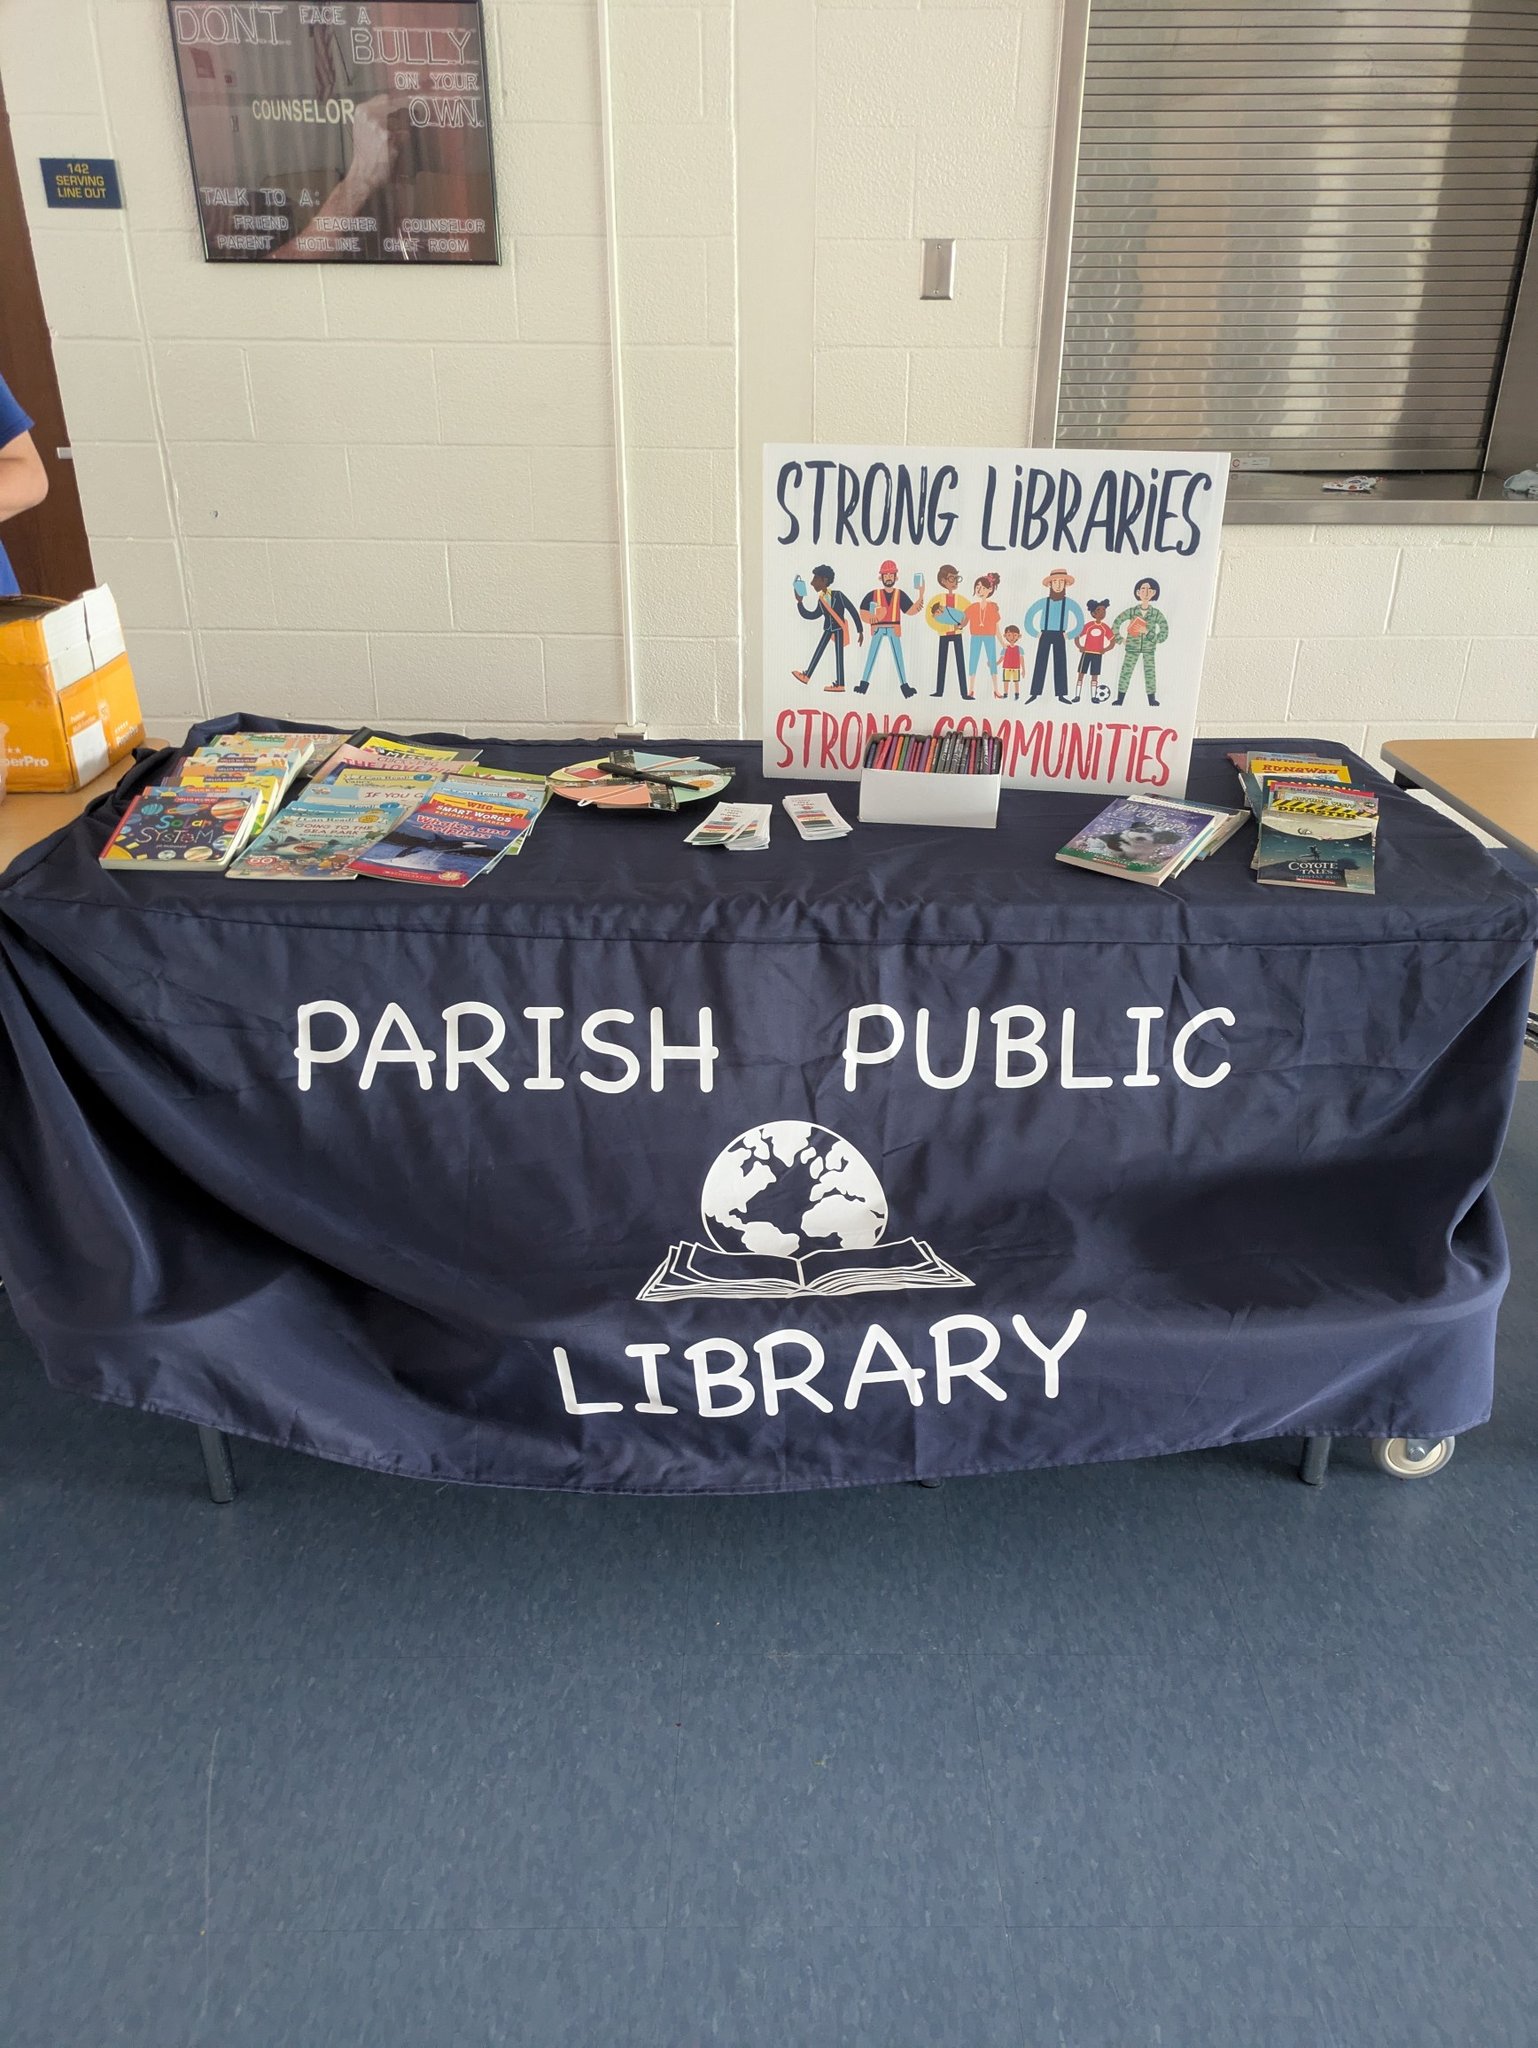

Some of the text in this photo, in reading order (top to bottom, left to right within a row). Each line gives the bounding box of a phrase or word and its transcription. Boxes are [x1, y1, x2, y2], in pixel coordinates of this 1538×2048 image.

[300, 6, 371, 25] FACE A
[351, 28, 472, 65] BULLY
[395, 72, 479, 92] ON YOUR
[251, 98, 355, 125] COUNSELOR
[409, 96, 485, 128] OWN.
[67, 163, 90, 175] 142
[55, 175, 105, 187] SERVING
[57, 187, 107, 199] LINE OUT
[200, 187, 320, 207] TALK TO A:
[233, 214, 486, 233] FRIEND TEACHER COUNSELOR
[217, 235, 470, 253] PARENT HOTLINE CHAT ROOM
[776, 460, 959, 548] STRONG
[364, 791, 381, 799] IF
[436, 805, 473, 816] SMART
[475, 812, 513, 822] WORDS
[467, 801, 494, 811] WHO
[1277, 806, 1357, 819] DISASTER
[417, 814, 511, 837] Whales and
[421, 824, 492, 840] Dolphins
[1288, 861, 1339, 871] COYOTE
[294, 1000, 1236, 1094] PARISH PUBLIC
[553, 1308, 1088, 1419] LIBRARY
